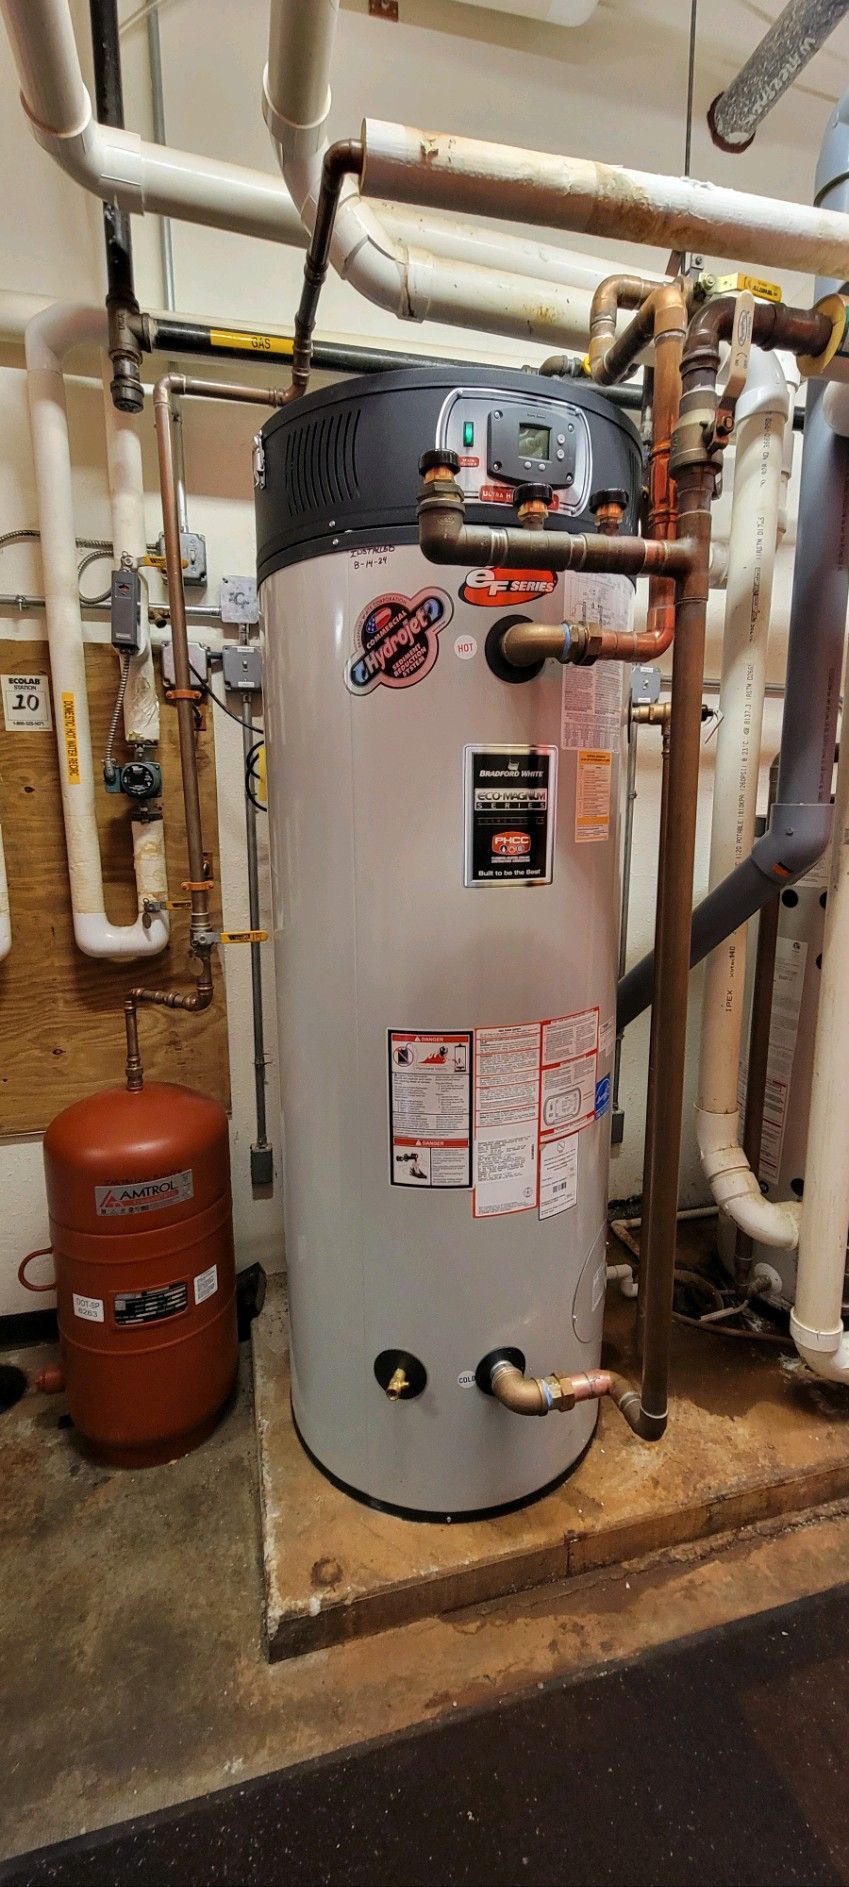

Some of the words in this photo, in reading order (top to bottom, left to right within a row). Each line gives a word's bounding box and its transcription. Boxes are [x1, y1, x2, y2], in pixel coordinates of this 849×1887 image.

[251, 336, 271, 349] GAS
[482, 490, 505, 500] ULTRA
[353, 556, 388, 570] 8-14-24
[511, 580, 555, 593] SERIES
[366, 610, 408, 650] COMMERCIAL
[363, 607, 429, 674] Hydrojet
[457, 643, 474, 652] HOT
[391, 642, 422, 670] SEDIMENT
[393, 646, 427, 678] REDUCTION
[402, 656, 425, 678] SYSTEM
[12, 694, 39, 712] 10
[63, 700, 76, 727] DOMESTIC
[66, 728, 76, 738] HOT
[67, 740, 78, 757] WATER
[479, 770, 520, 778] BRADFORD
[521, 770, 544, 778] WHITE
[495, 836, 529, 844] PHCC
[735, 819, 744, 844] POTABLE
[724, 988, 734, 1013] IPEX
[120, 1180, 178, 1201] AMTROL
[458, 1375, 476, 1384] COLD
